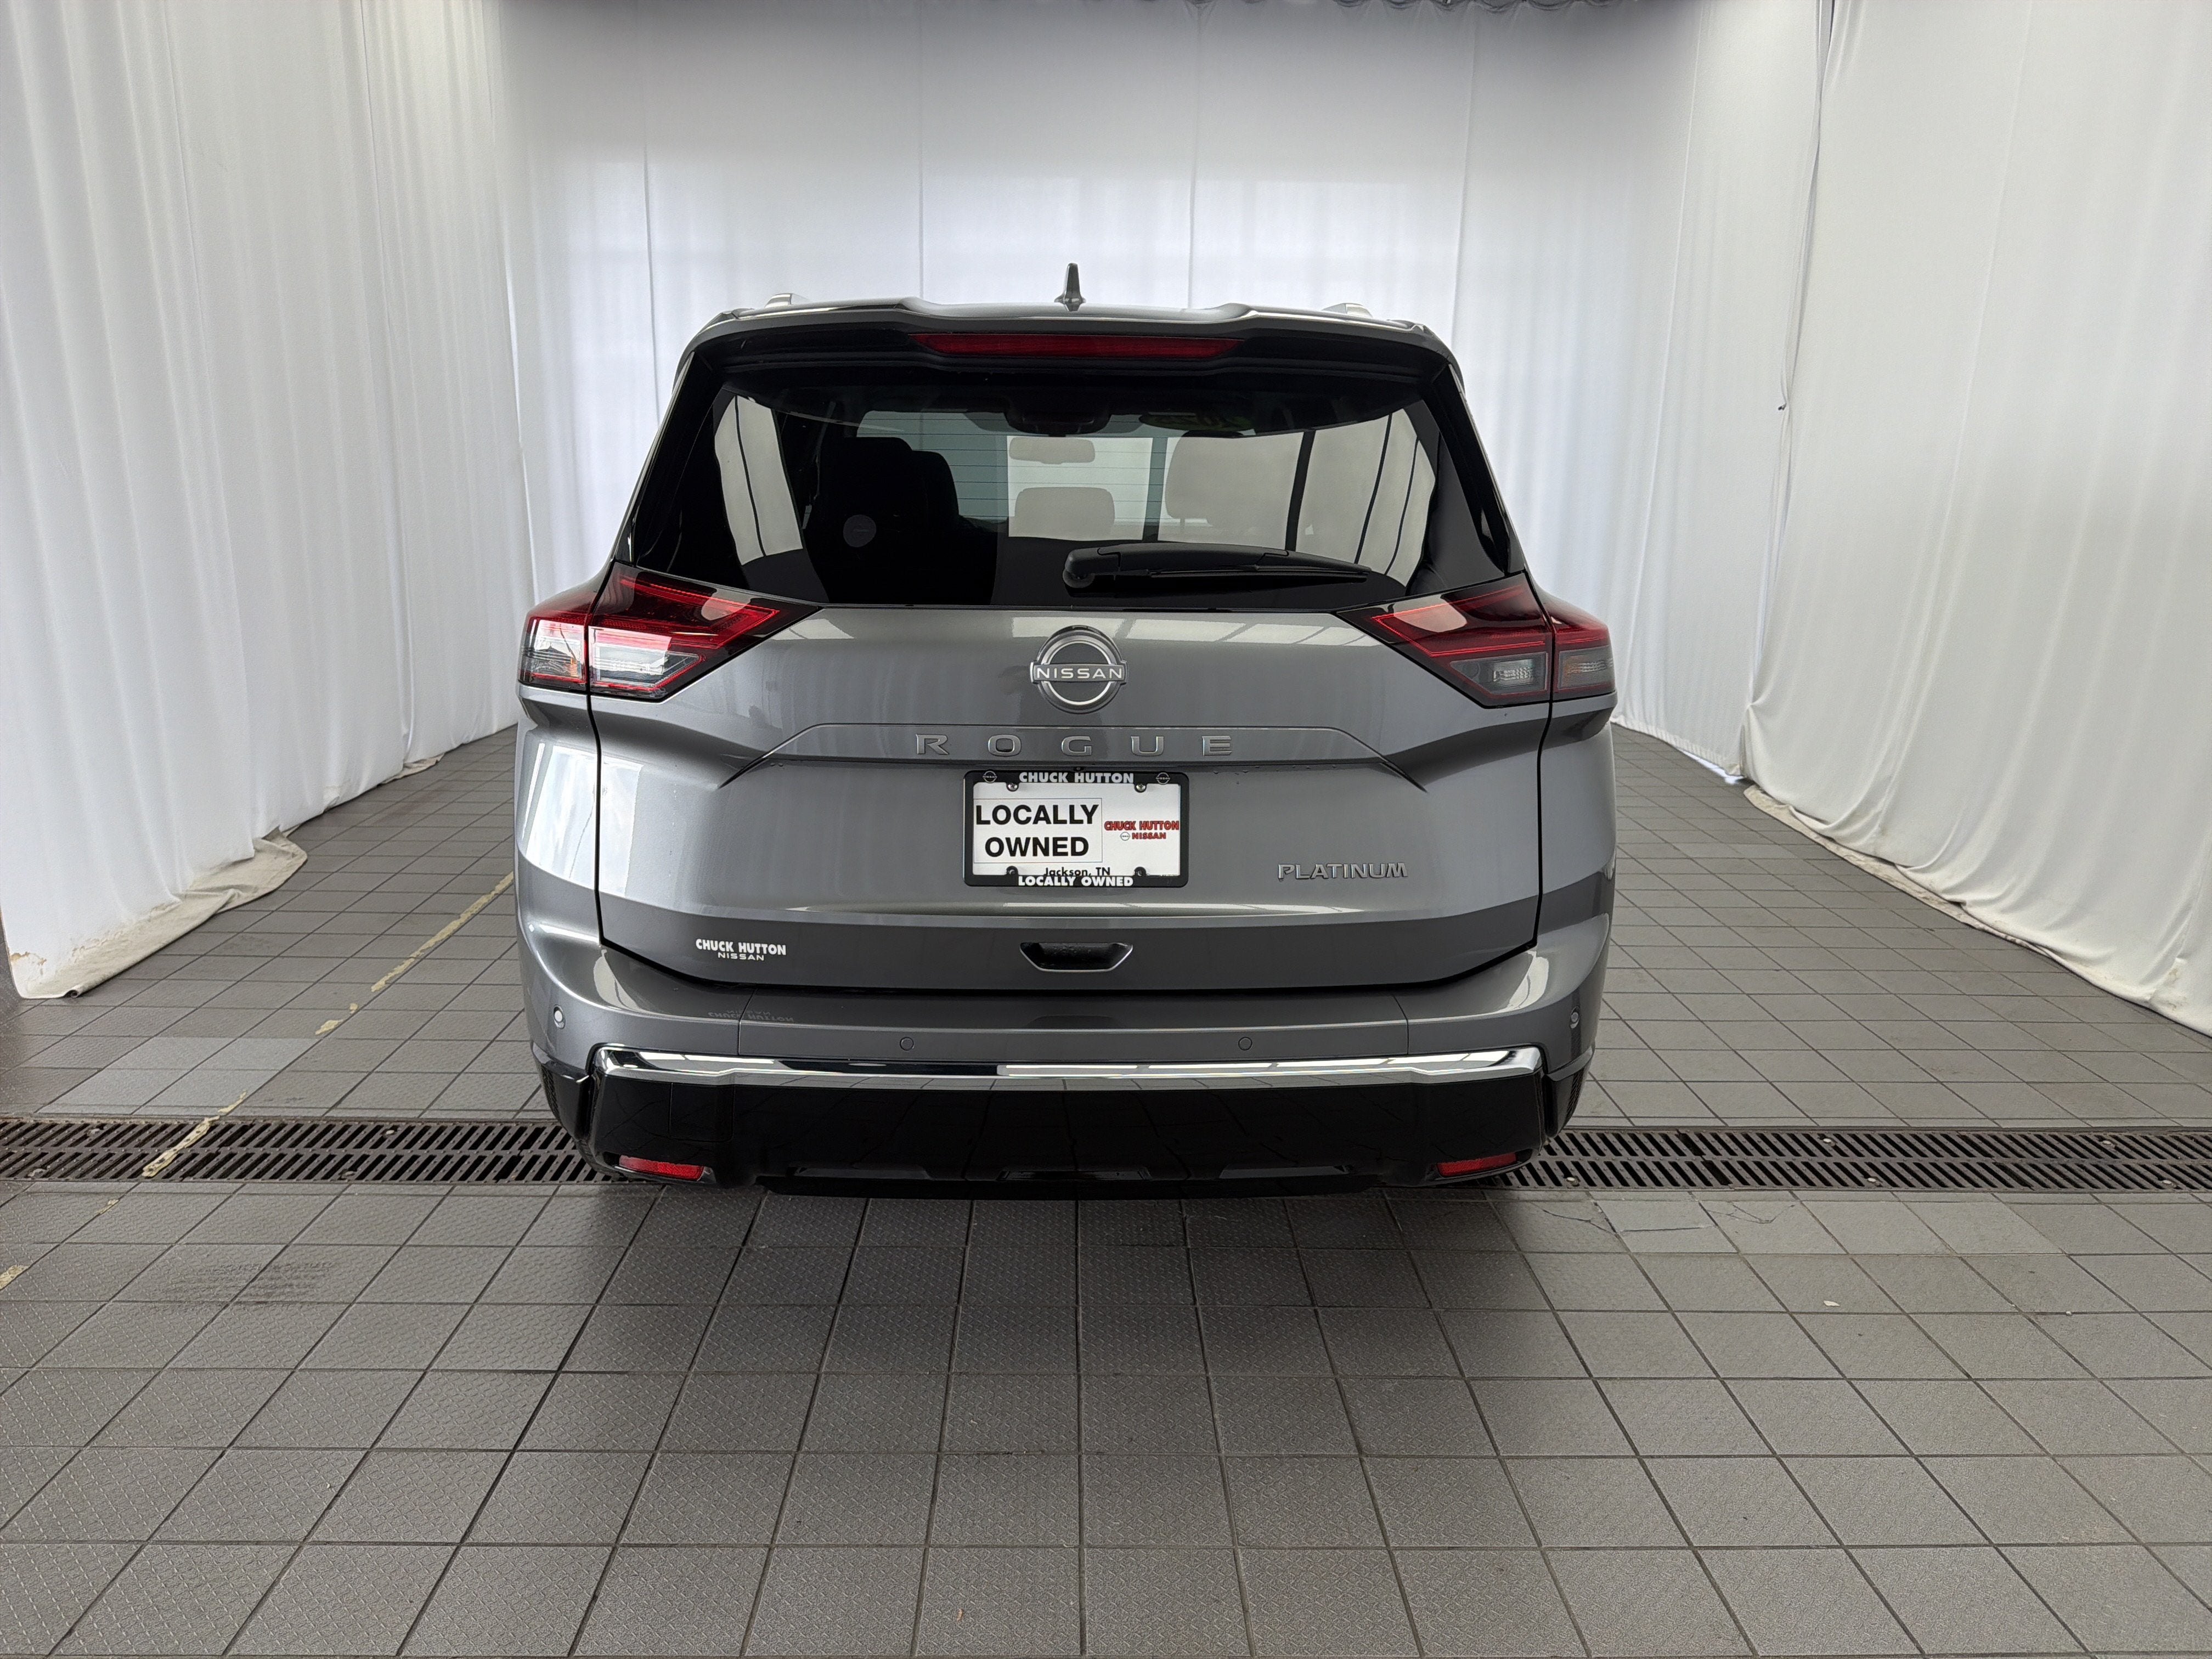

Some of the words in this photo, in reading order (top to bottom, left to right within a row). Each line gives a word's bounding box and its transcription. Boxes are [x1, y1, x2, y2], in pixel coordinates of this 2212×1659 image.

[1037, 668, 1122, 679] NISSAN
[915, 733, 1233, 757] ROGUE
[1019, 772, 1069, 783] CHUCK
[1075, 772, 1134, 783] HUTTON
[976, 804, 1099, 825] LOCALLY
[1104, 821, 1136, 831] CHUCK
[1139, 820, 1180, 831] HUTTON
[985, 837, 1089, 857] OWNED
[1096, 867, 1110, 876] TN
[1278, 862, 1408, 879] PLATINUM
[1018, 876, 1076, 887] LOCALLY
[1081, 876, 1133, 887] OWNED
[696, 939, 735, 952] CHUCK
[738, 942, 786, 956] HUTTON
[718, 952, 764, 961] NISSAN
